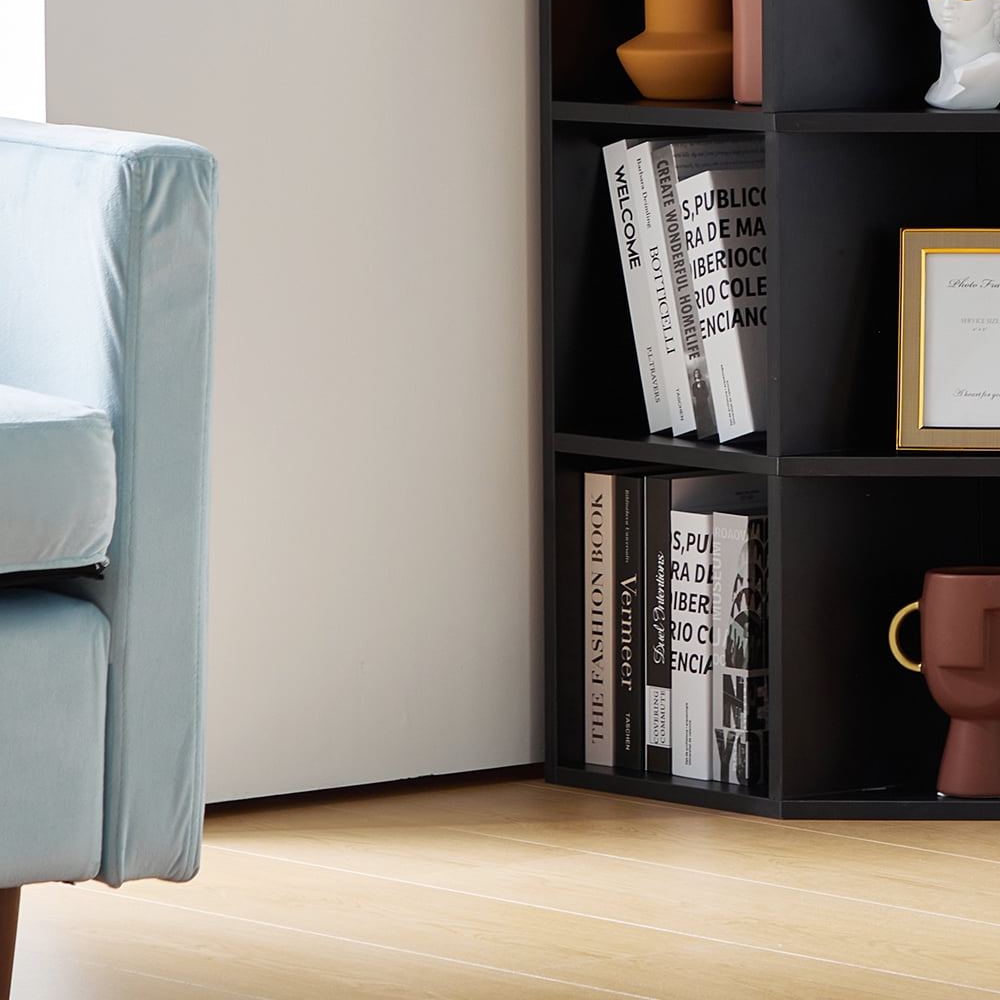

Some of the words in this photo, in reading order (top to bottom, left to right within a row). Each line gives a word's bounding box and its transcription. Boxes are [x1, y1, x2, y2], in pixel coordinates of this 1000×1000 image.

[657, 160, 675, 207] CREATE
[615, 165, 641, 270] WELCOME
[665, 209, 690, 292] WONDERFUL
[685, 227, 704, 250] RA
[708, 219, 731, 242] DE
[649, 246, 676, 354] BOTTICELLI
[947, 276, 978, 288] Photo
[679, 294, 700, 360] HOMELIFE
[591, 493, 604, 562] BOOK
[672, 530, 713, 556] S,PU
[591, 572, 604, 684] FASHION
[620, 573, 637, 692] Vermeer
[591, 692, 604, 744] THE
[624, 713, 632, 751] TASCHEN
